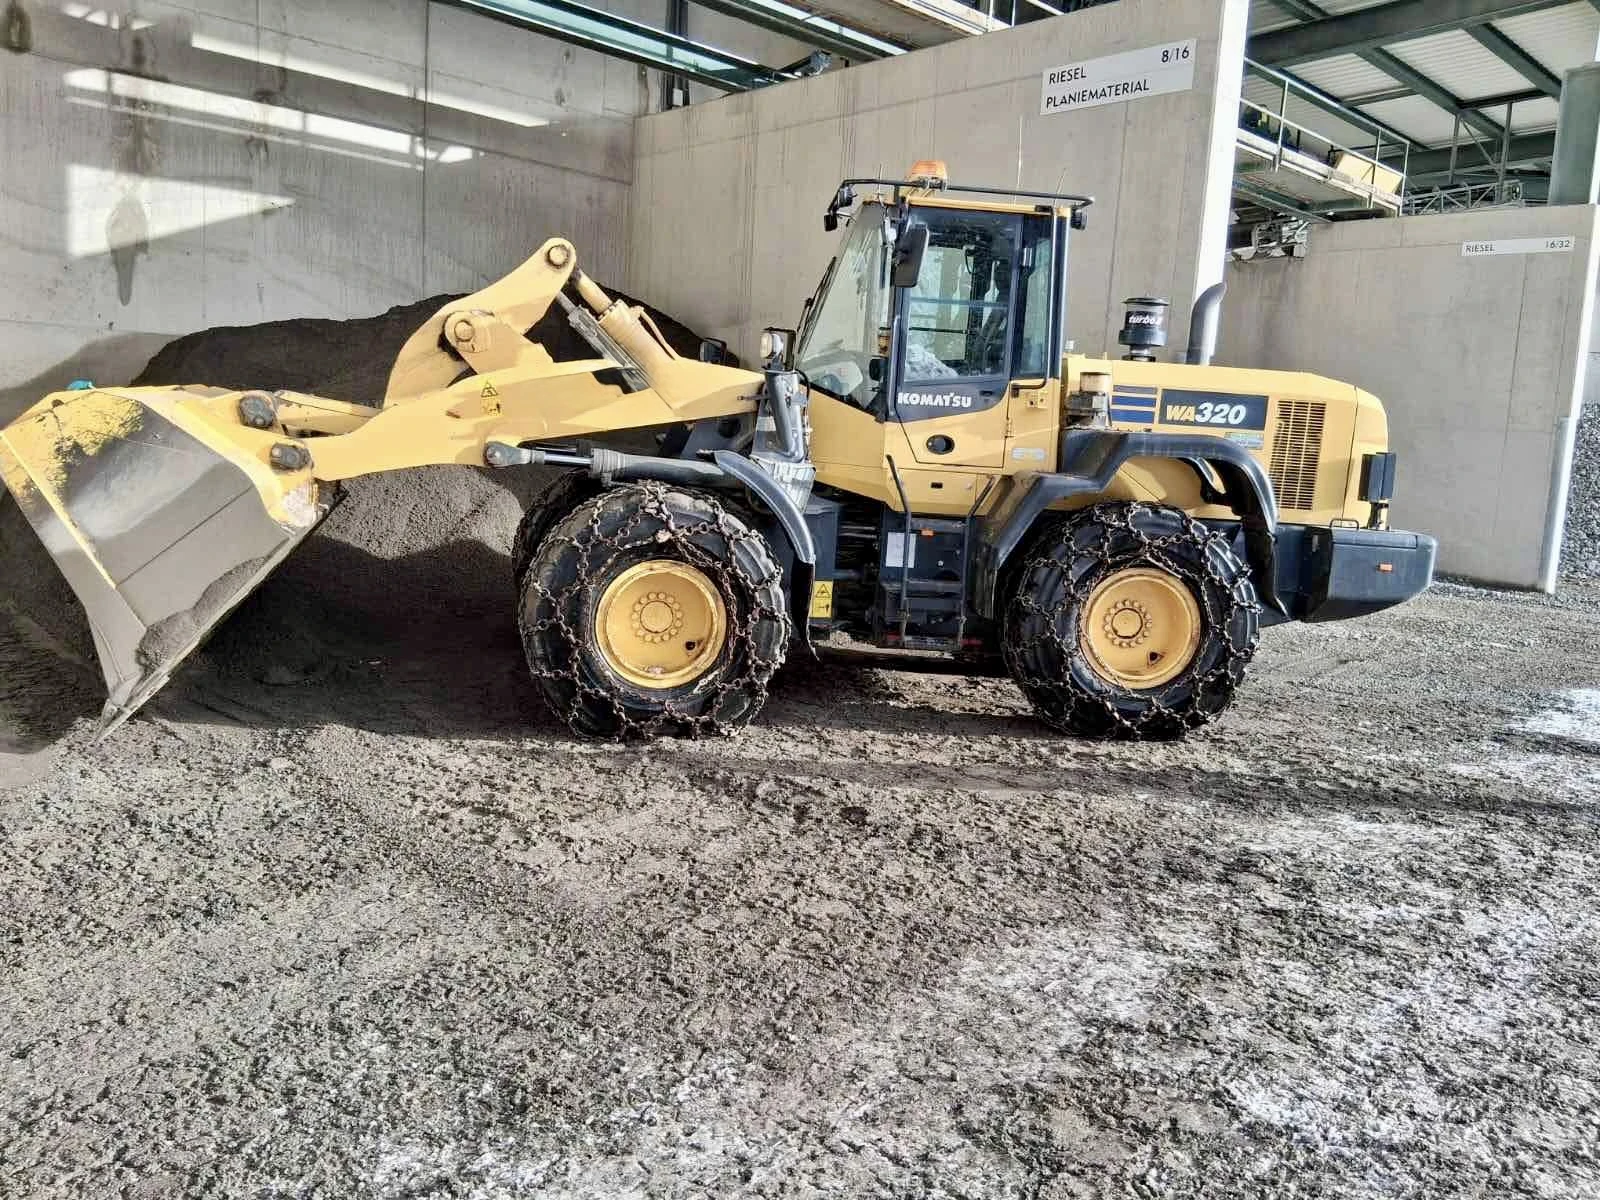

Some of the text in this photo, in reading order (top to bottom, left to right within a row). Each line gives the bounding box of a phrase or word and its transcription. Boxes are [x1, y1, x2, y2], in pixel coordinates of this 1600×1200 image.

[1049, 46, 1190, 85] RIESEL 8/16
[1046, 79, 1150, 109] PLANIEMATERIAL
[1465, 243, 1495, 253] RIESEL
[897, 392, 972, 408] KOMATSU
[1166, 402, 1247, 425] WA320
